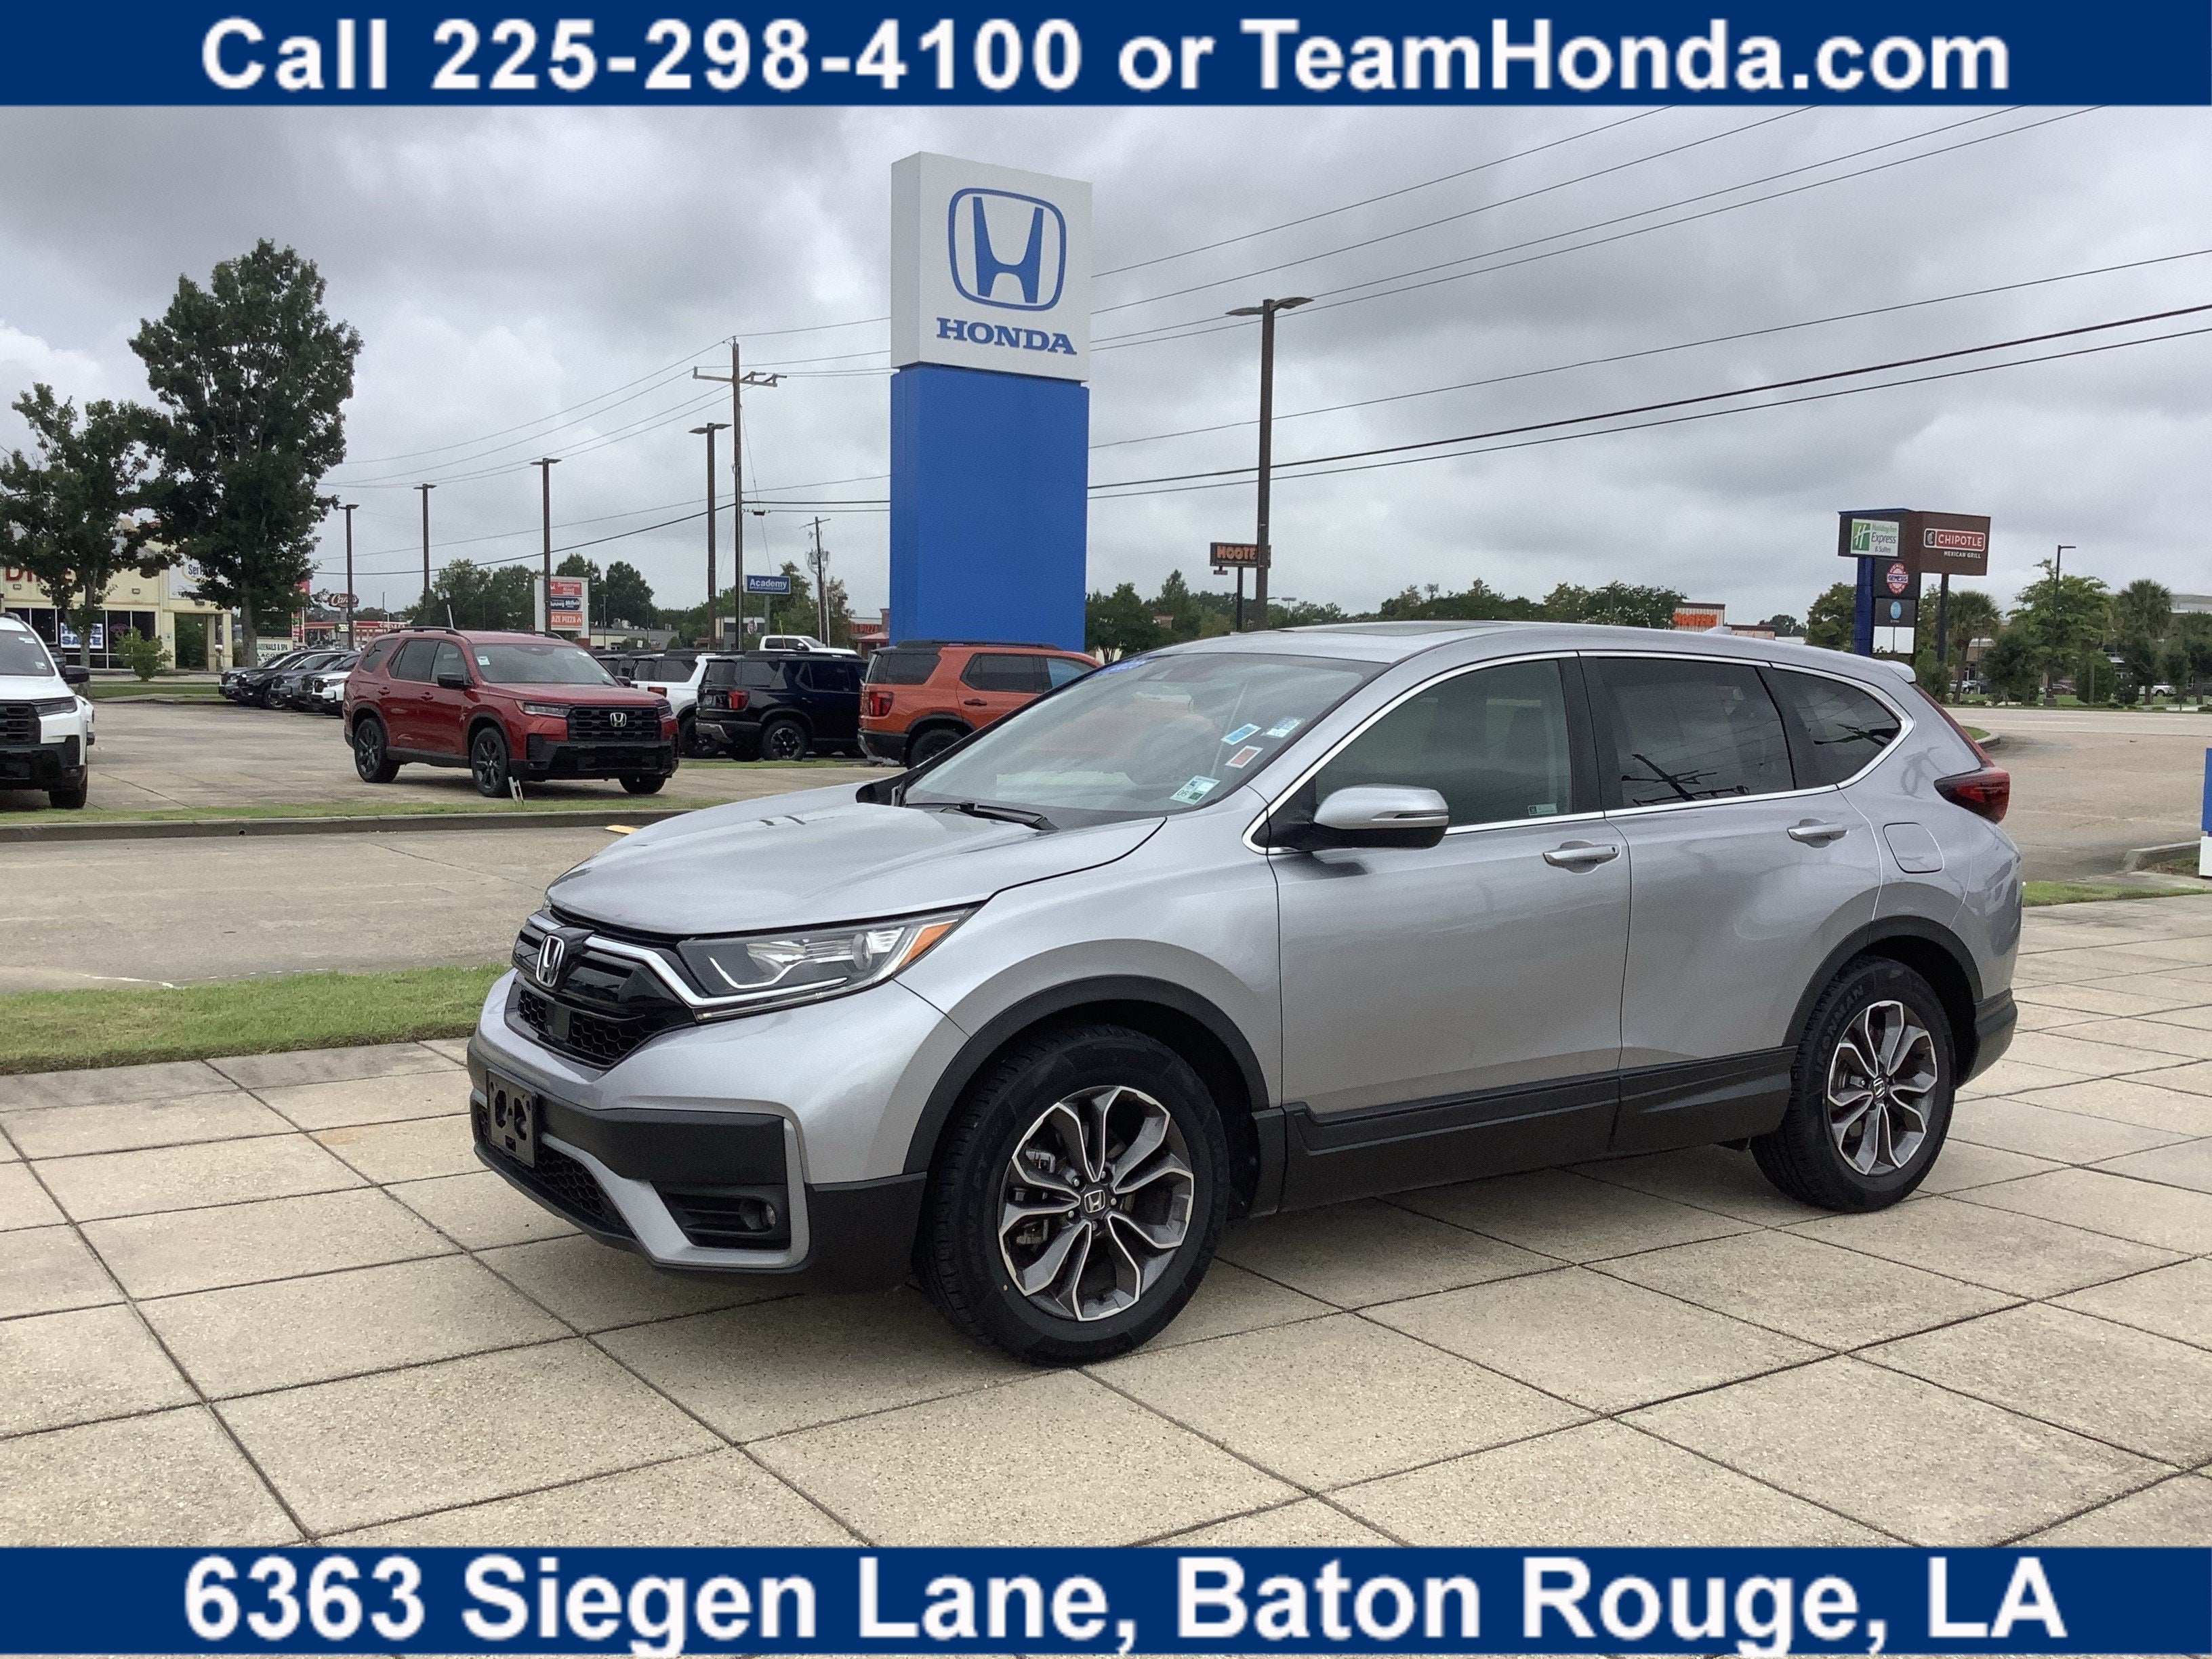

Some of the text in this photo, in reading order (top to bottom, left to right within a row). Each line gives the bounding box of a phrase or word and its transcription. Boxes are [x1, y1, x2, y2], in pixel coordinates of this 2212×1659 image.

[937, 317, 1077, 355] HONDA
[1871, 532, 1896, 545] Express
[1938, 534, 1982, 547] CHIPOTLE
[750, 578, 787, 590] Academy
